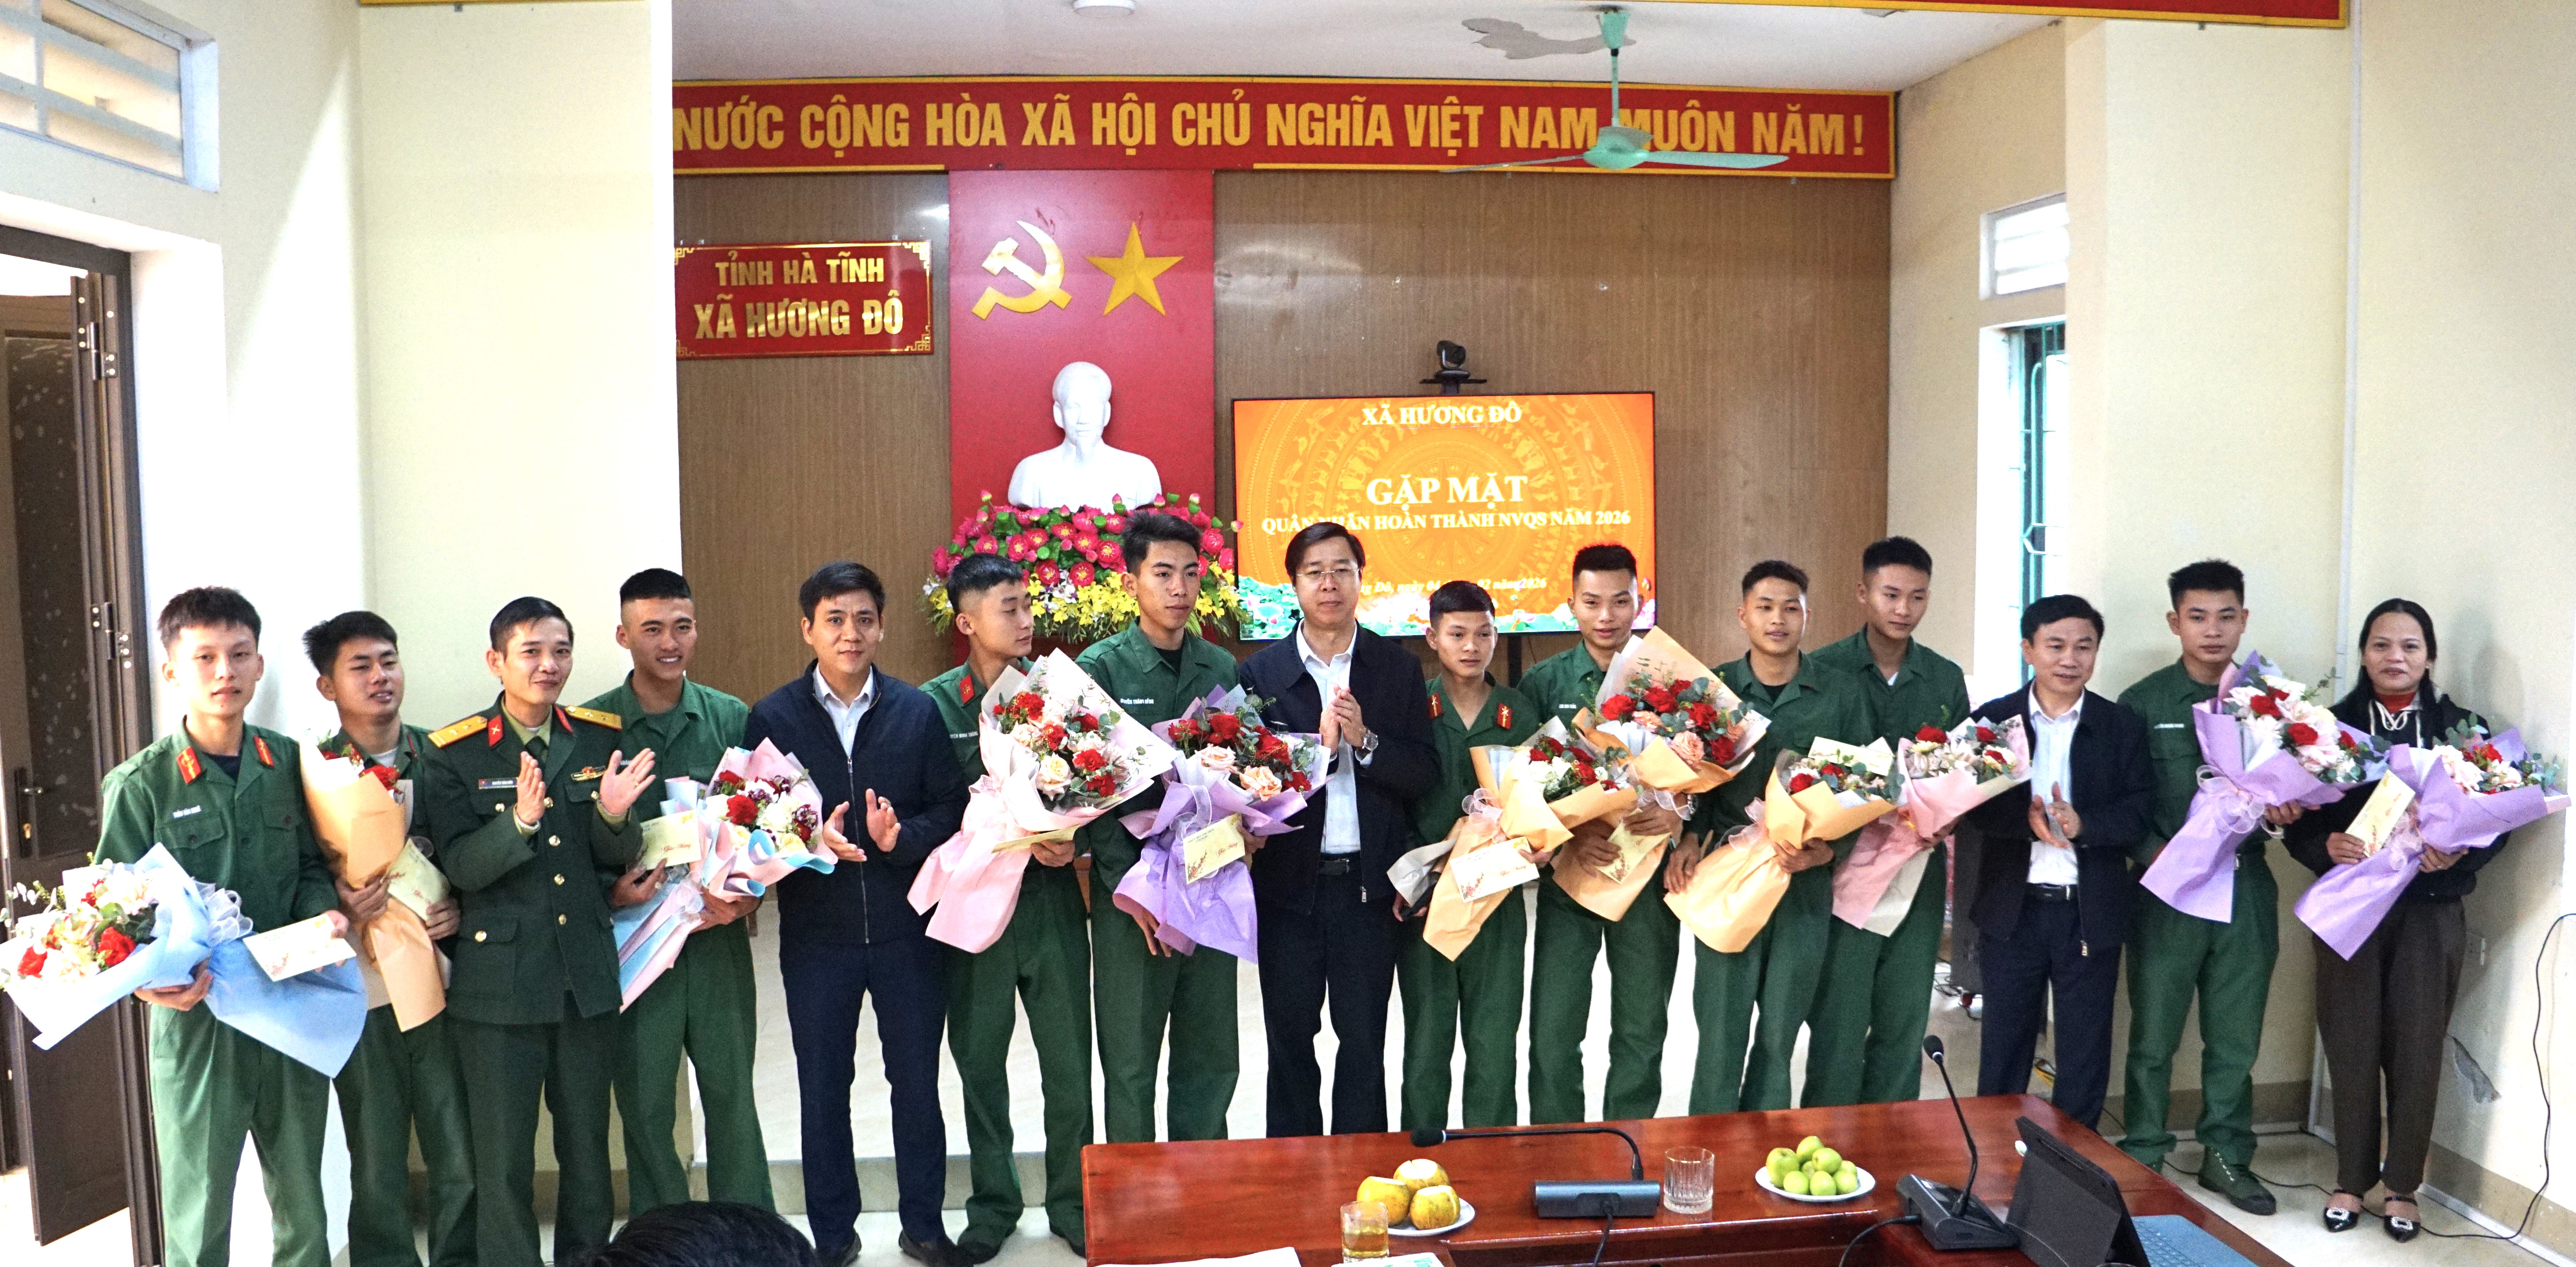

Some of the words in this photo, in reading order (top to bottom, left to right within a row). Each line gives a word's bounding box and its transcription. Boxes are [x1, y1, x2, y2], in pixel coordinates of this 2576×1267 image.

[673, 95, 784, 151] NƯỚC
[800, 95, 910, 158] CỘNG
[926, 93, 1007, 147] HÒA
[1021, 93, 1076, 146] XÃ
[1092, 92, 1156, 155] HỘI
[1171, 88, 1250, 146] CHỦ
[1266, 95, 1394, 147] NGHĨA
[1404, 95, 1484, 156] VIỆT
[1500, 106, 1597, 149] NAM
[715, 250, 774, 286] TỈNH
[783, 251, 818, 284] HÀ
[826, 251, 884, 284] TĨNH
[694, 294, 737, 339] XÃ
[746, 298, 850, 338] HƯƠNG
[862, 289, 904, 335] ĐÔ
[1362, 404, 1394, 425] XÃ
[1399, 404, 1484, 425] HƯƠNG
[1488, 401, 1522, 423] ĐÔ
[1366, 474, 1440, 511] GẶP
[1446, 472, 1528, 510] MẶT
[1374, 511, 1427, 529] HOÀN
[1431, 510, 1496, 528] THÀNH
[1499, 512, 1547, 529] NVQS
[1549, 508, 1592, 526] NĂM
[1595, 511, 1631, 525] 2026
[1397, 580, 1425, 593] ngày
[1426, 580, 1441, 591] 04
